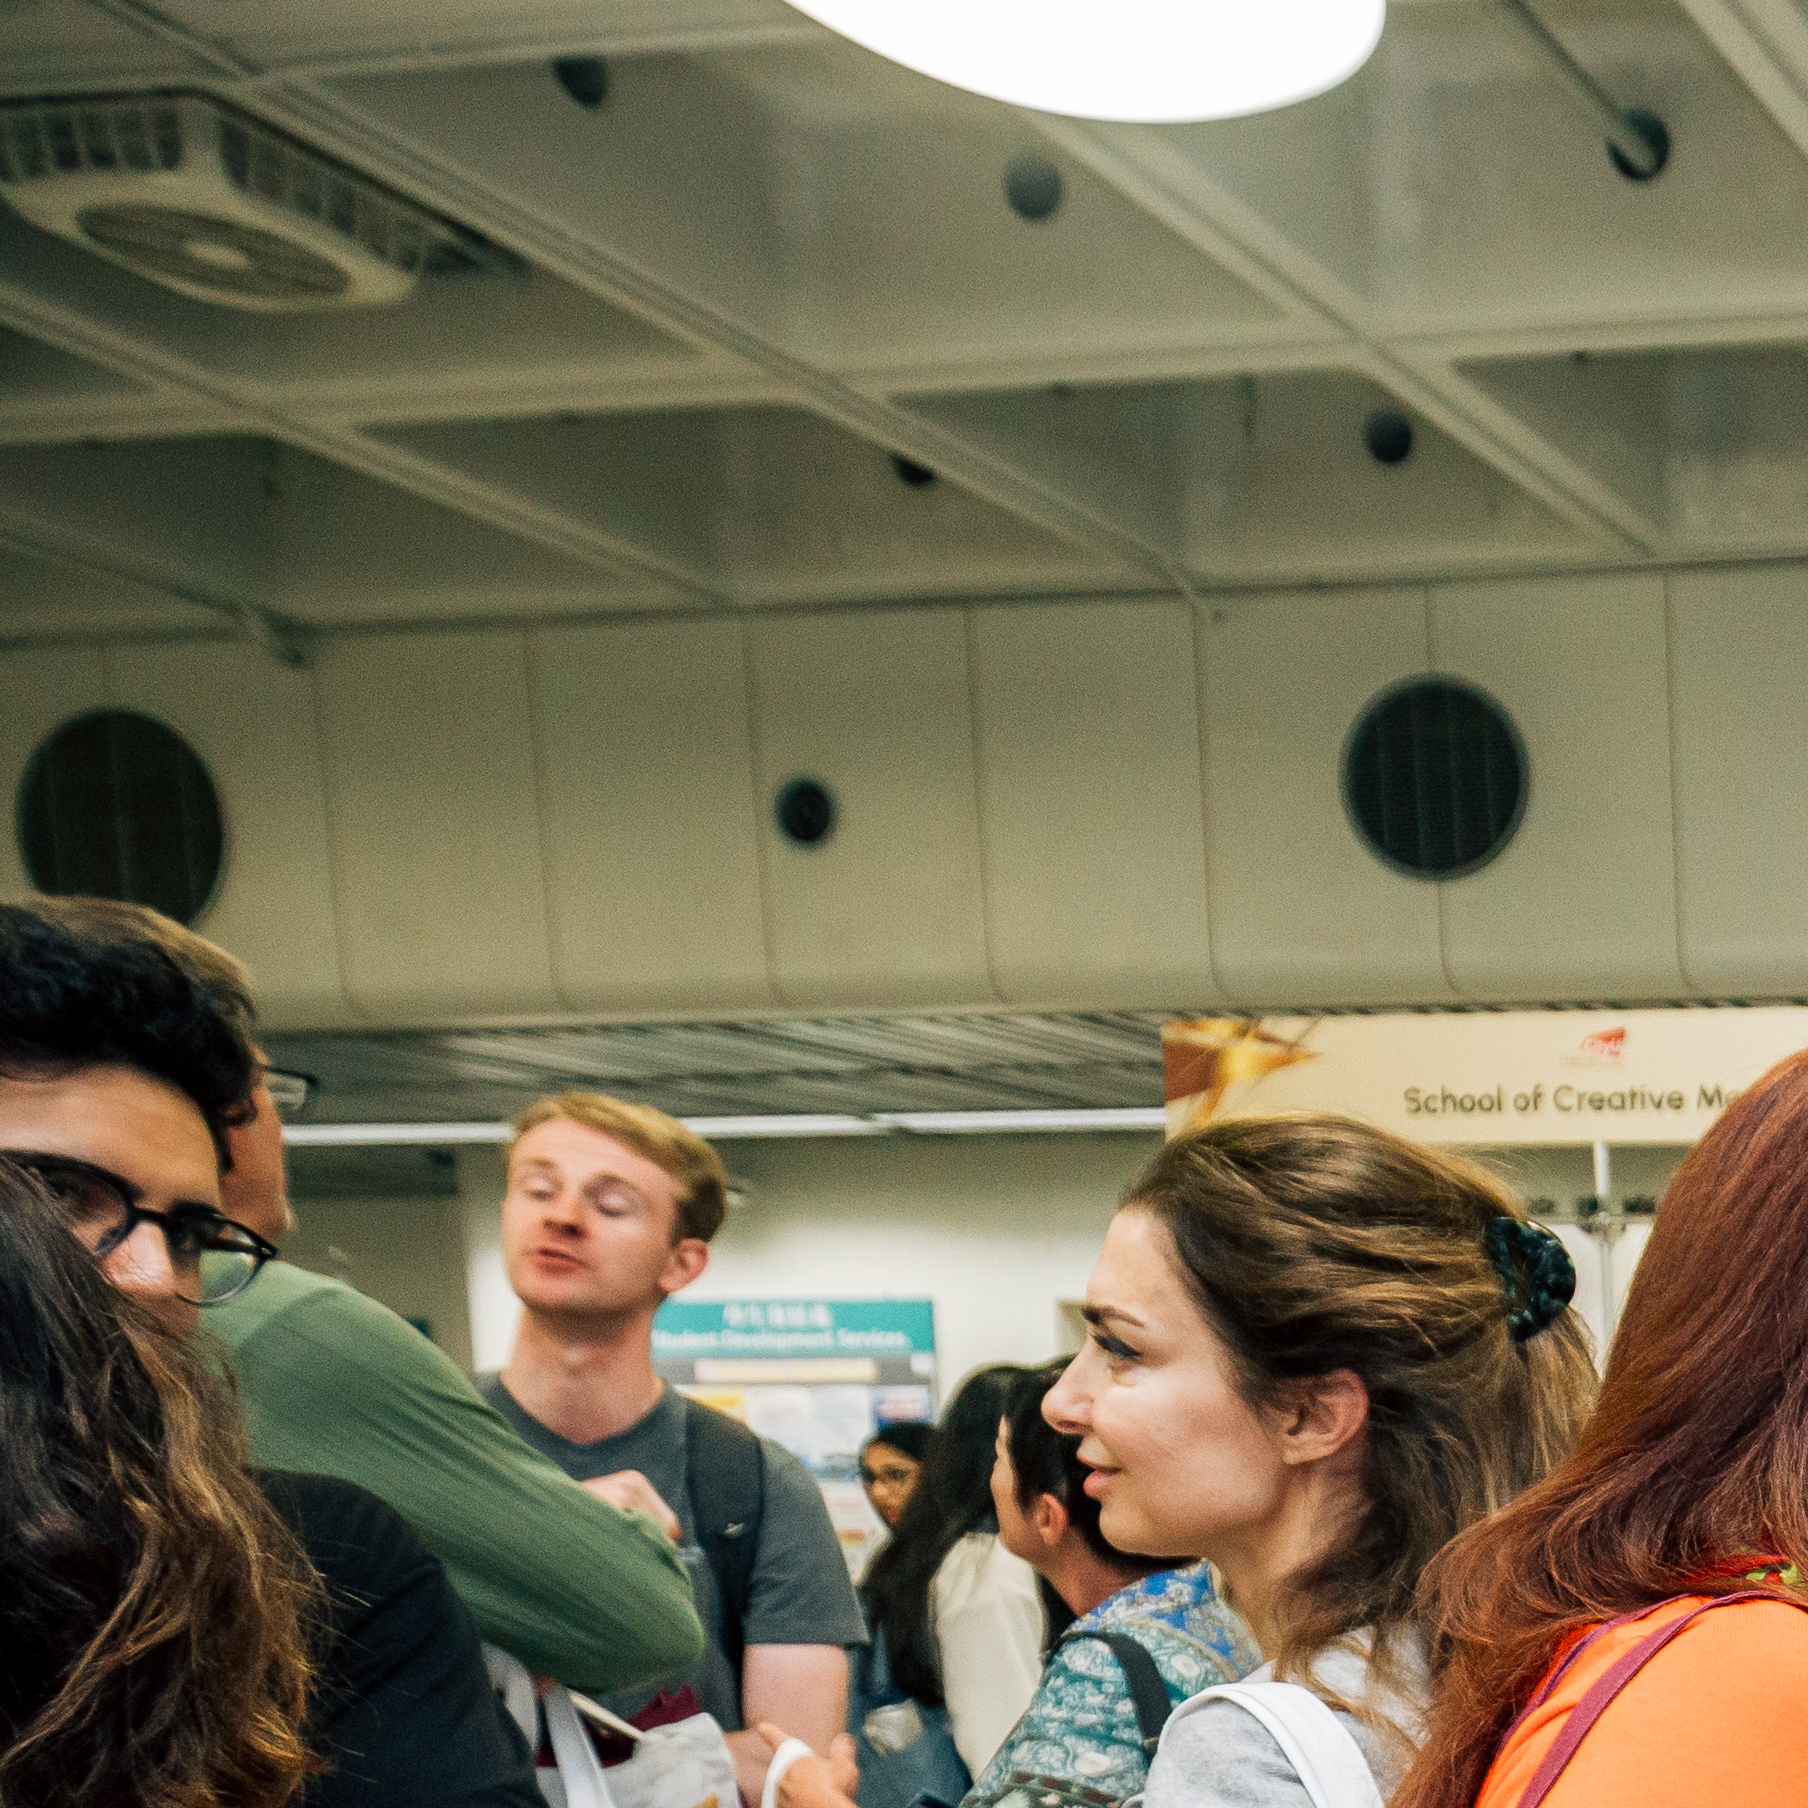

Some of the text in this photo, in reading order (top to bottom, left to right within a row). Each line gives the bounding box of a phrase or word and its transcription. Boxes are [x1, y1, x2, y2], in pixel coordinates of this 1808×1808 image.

[1403, 1083, 1685, 1115] School of Creative
